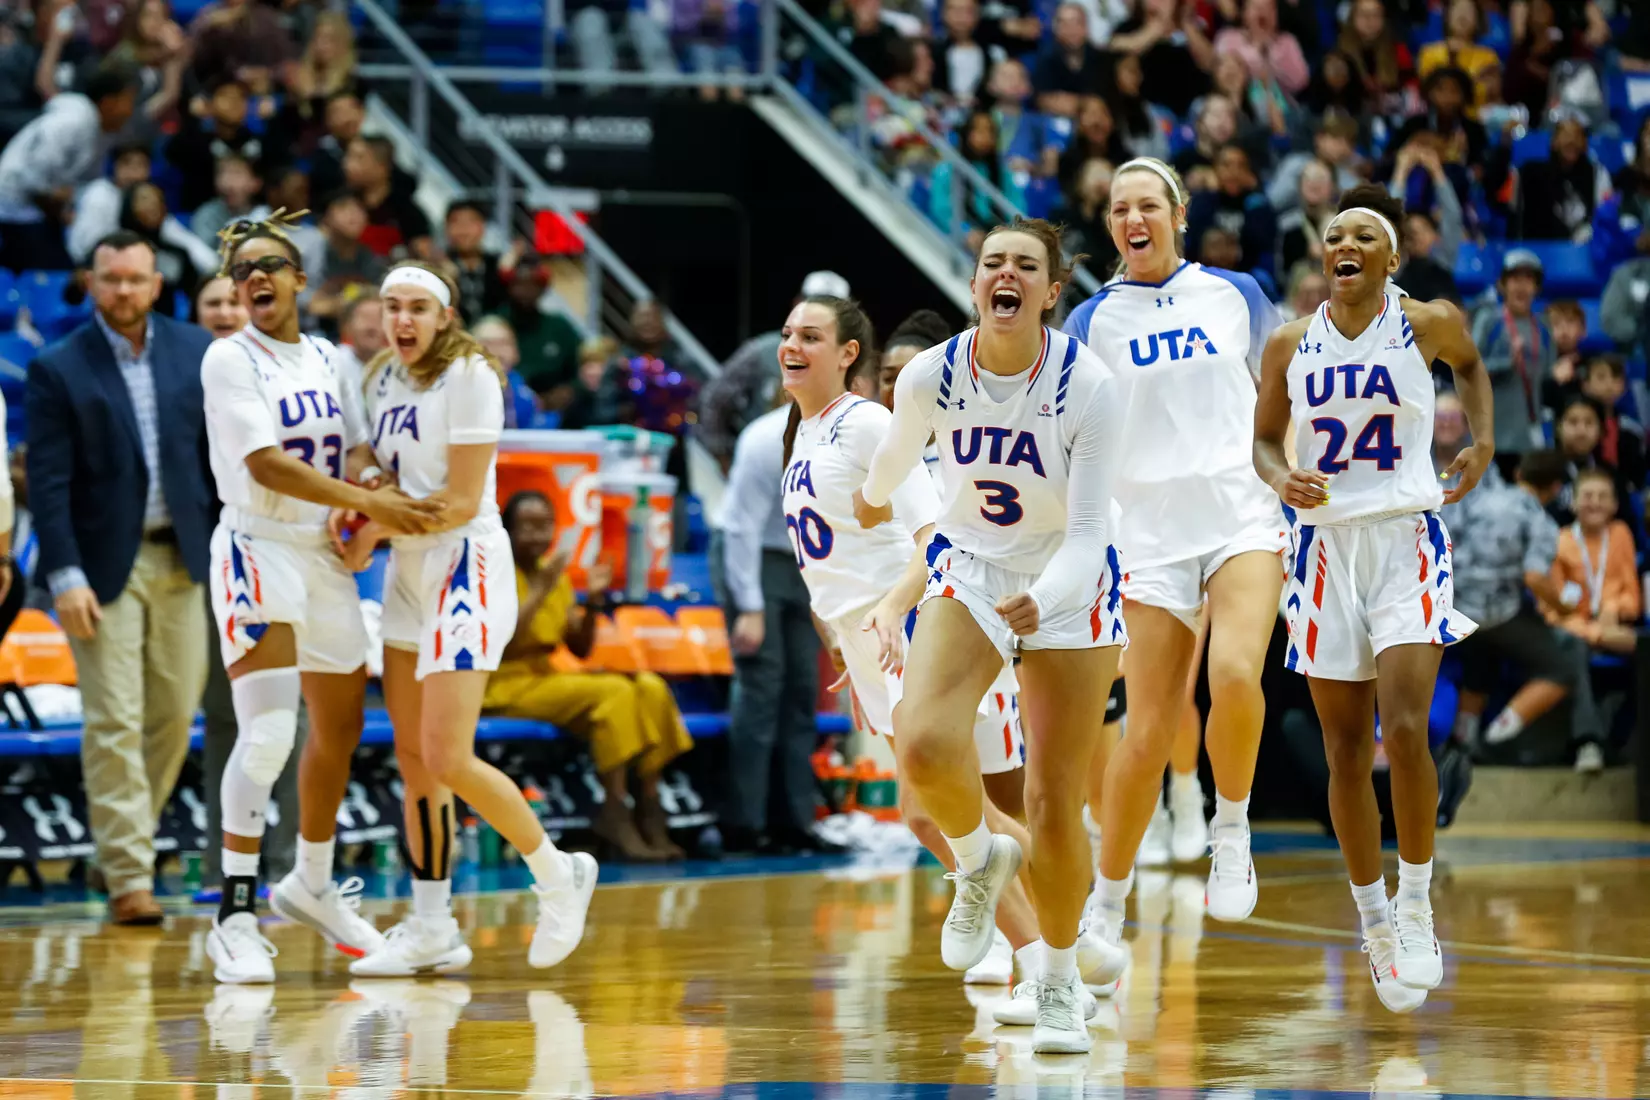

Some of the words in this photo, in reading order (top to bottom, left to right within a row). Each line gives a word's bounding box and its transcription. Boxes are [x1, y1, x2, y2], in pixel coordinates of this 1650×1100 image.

[457, 113, 568, 142] EVATOR
[1129, 326, 1218, 367] UTA
[279, 390, 344, 428] UTA
[1305, 364, 1401, 408] UTA
[282, 434, 342, 480] 33
[952, 426, 1047, 479] UTA
[1311, 413, 1402, 475] 24
[569, 473, 603, 526] G
[973, 480, 1024, 527] 3
